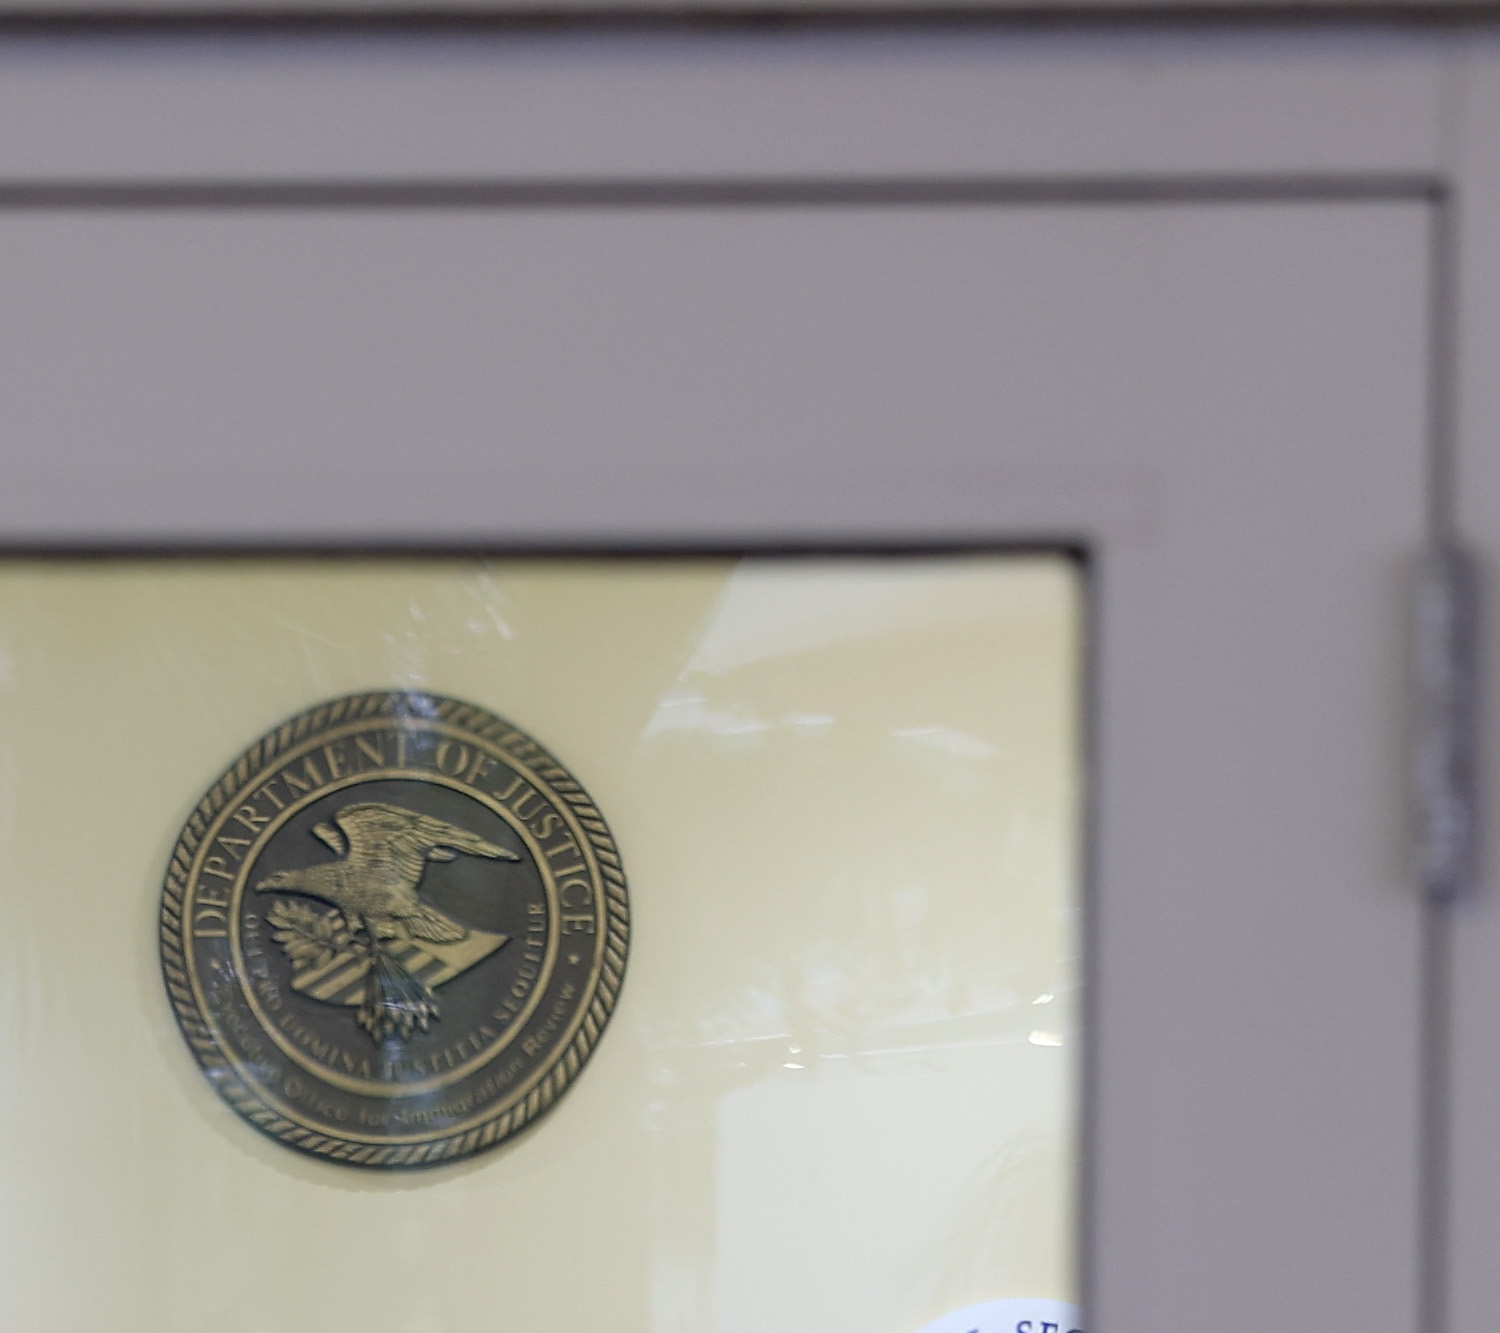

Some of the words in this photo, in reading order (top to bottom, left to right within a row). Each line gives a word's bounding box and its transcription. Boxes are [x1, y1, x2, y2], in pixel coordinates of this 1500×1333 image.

[194, 734, 412, 939] DEPARTMENT
[436, 735, 499, 786] OF
[493, 771, 596, 937] JUSTICE
